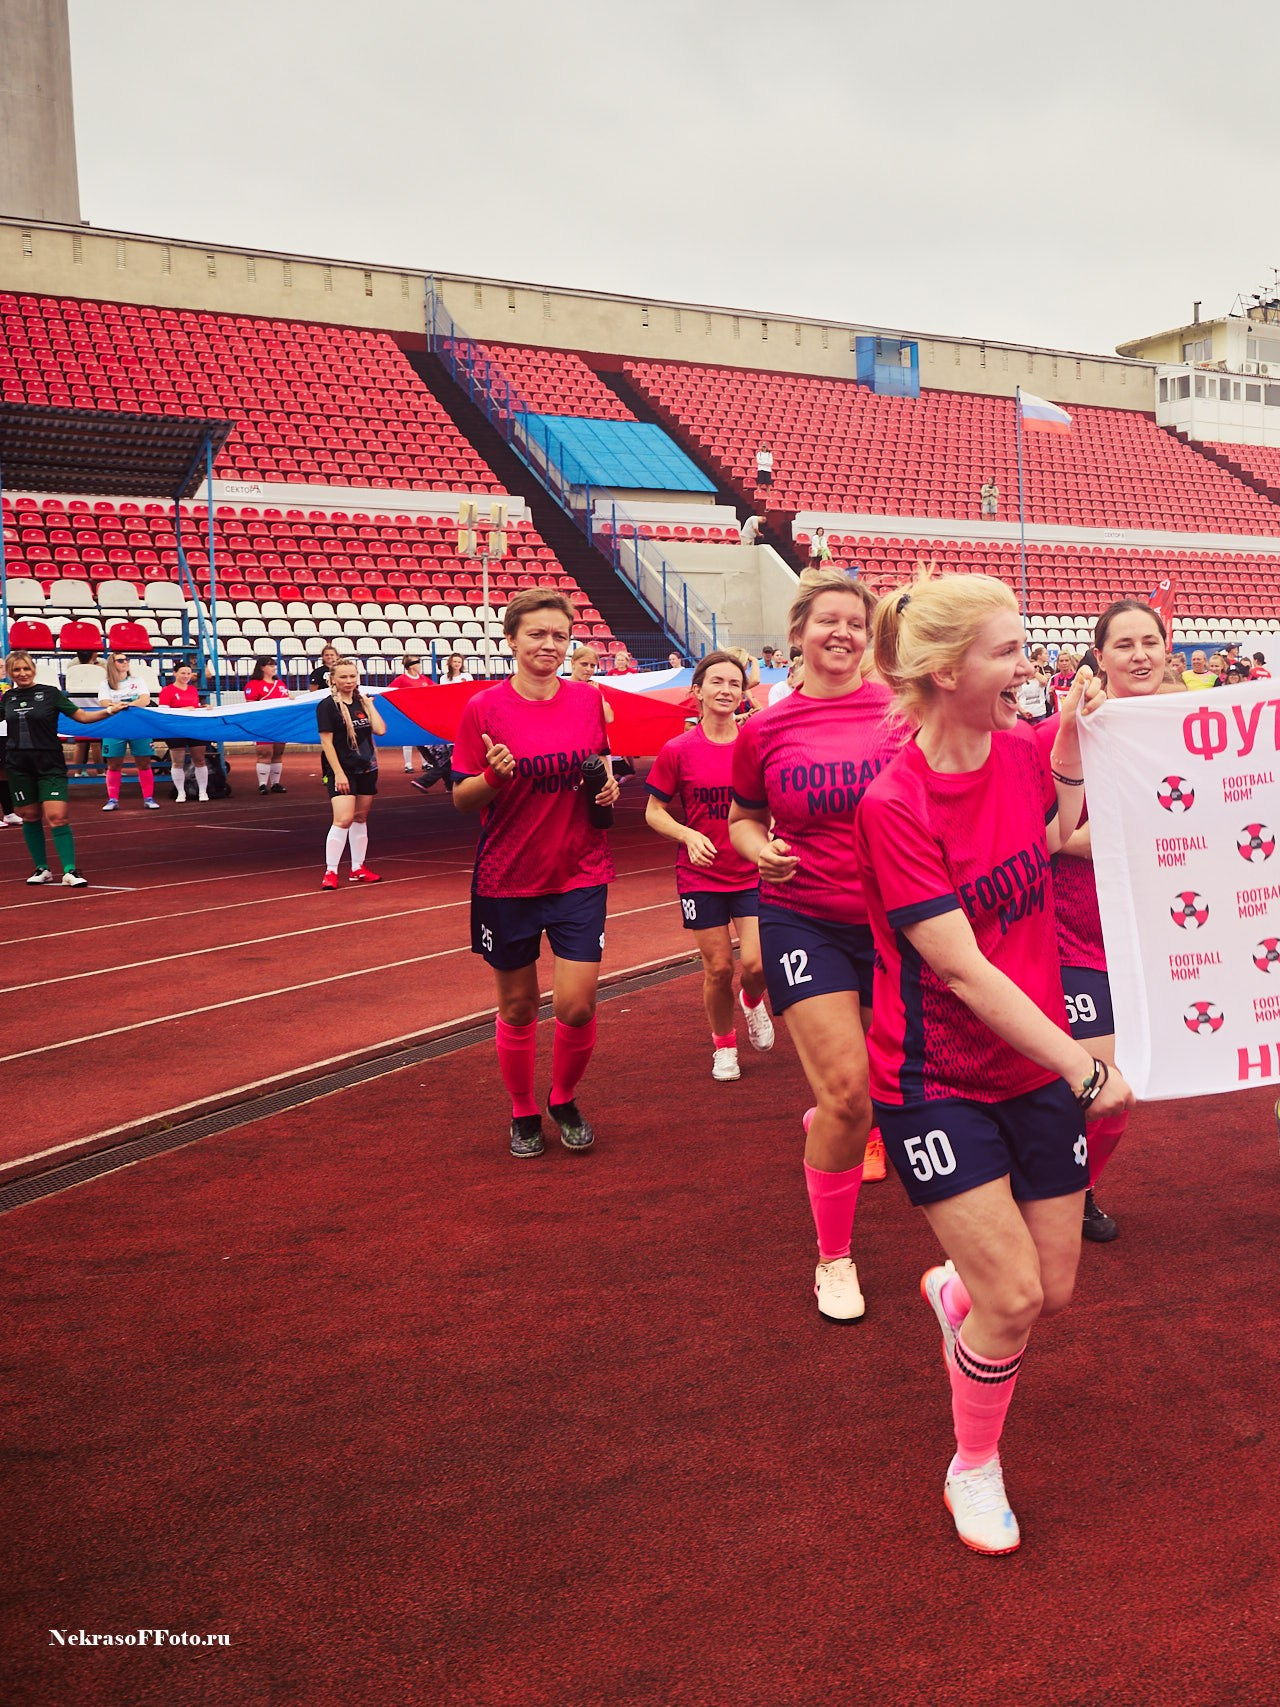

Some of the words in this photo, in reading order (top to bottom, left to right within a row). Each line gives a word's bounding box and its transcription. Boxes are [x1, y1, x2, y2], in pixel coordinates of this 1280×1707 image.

[1222, 771, 1275, 789] FOOTBALL
[14, 790, 26, 801] 11
[807, 786, 867, 816] MOM
[1224, 787, 1253, 803] MOM!
[708, 803, 730, 820] MO
[1155, 835, 1208, 852] FOOTBALL
[1158, 852, 1187, 867] MOM!
[1238, 902, 1268, 919] MOM!
[481, 923, 493, 952] 25
[779, 949, 813, 987] 12
[1168, 951, 1223, 968] FOOTBALL
[1170, 966, 1200, 981] MOM!
[1063, 993, 1098, 1024] 69
[903, 1129, 957, 1183] 50
